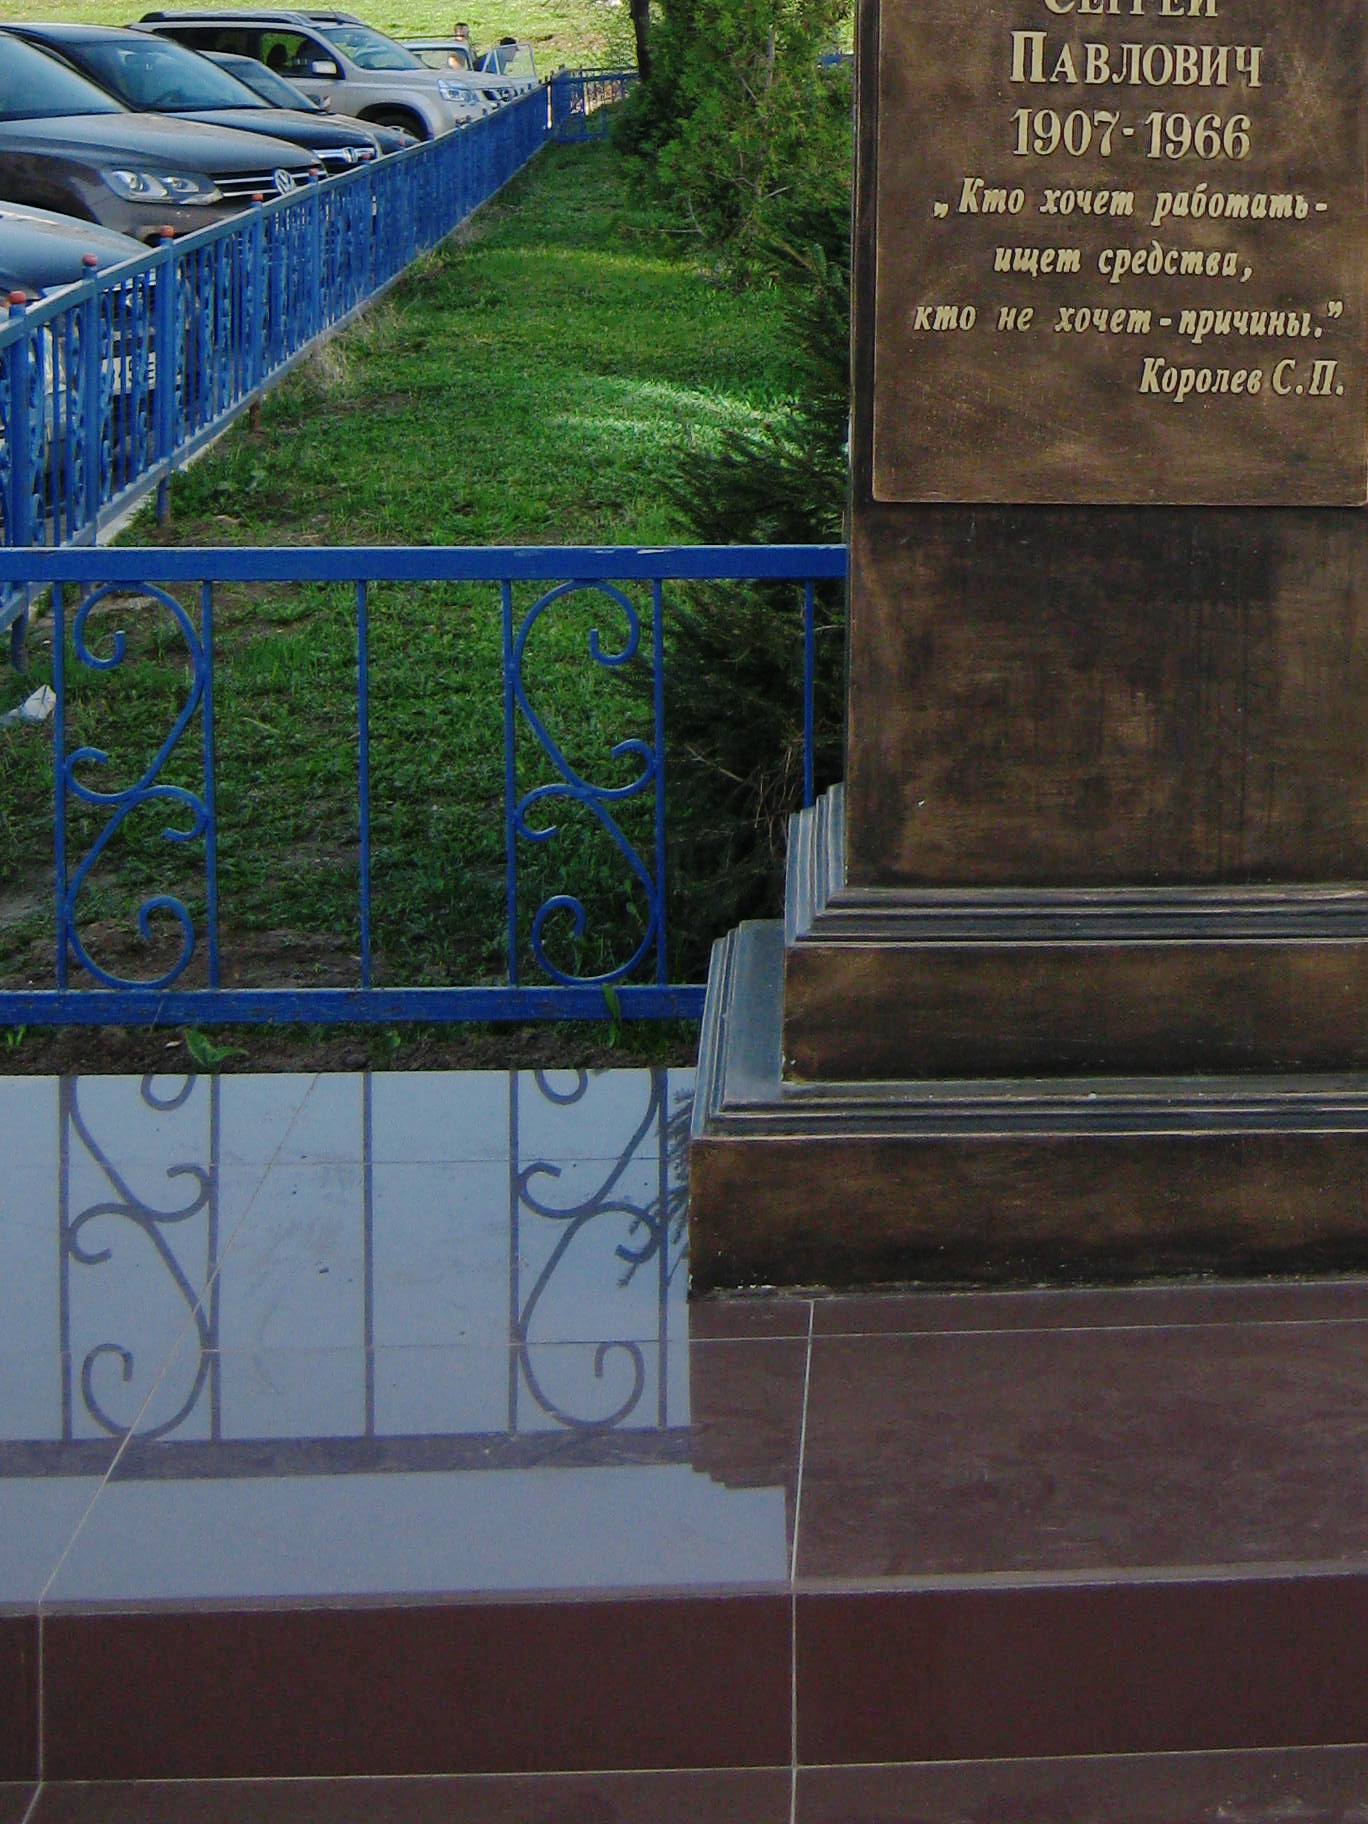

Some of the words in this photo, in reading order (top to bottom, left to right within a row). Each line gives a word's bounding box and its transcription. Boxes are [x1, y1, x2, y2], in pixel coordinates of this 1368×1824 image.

[1039, 189, 1136, 216] хочет
[994, 247, 1082, 278] ищет
[1098, 239, 1254, 285] средства,
[913, 305, 977, 332] кто
[998, 306, 1035, 332] не
[1139, 357, 1264, 404] Королев
